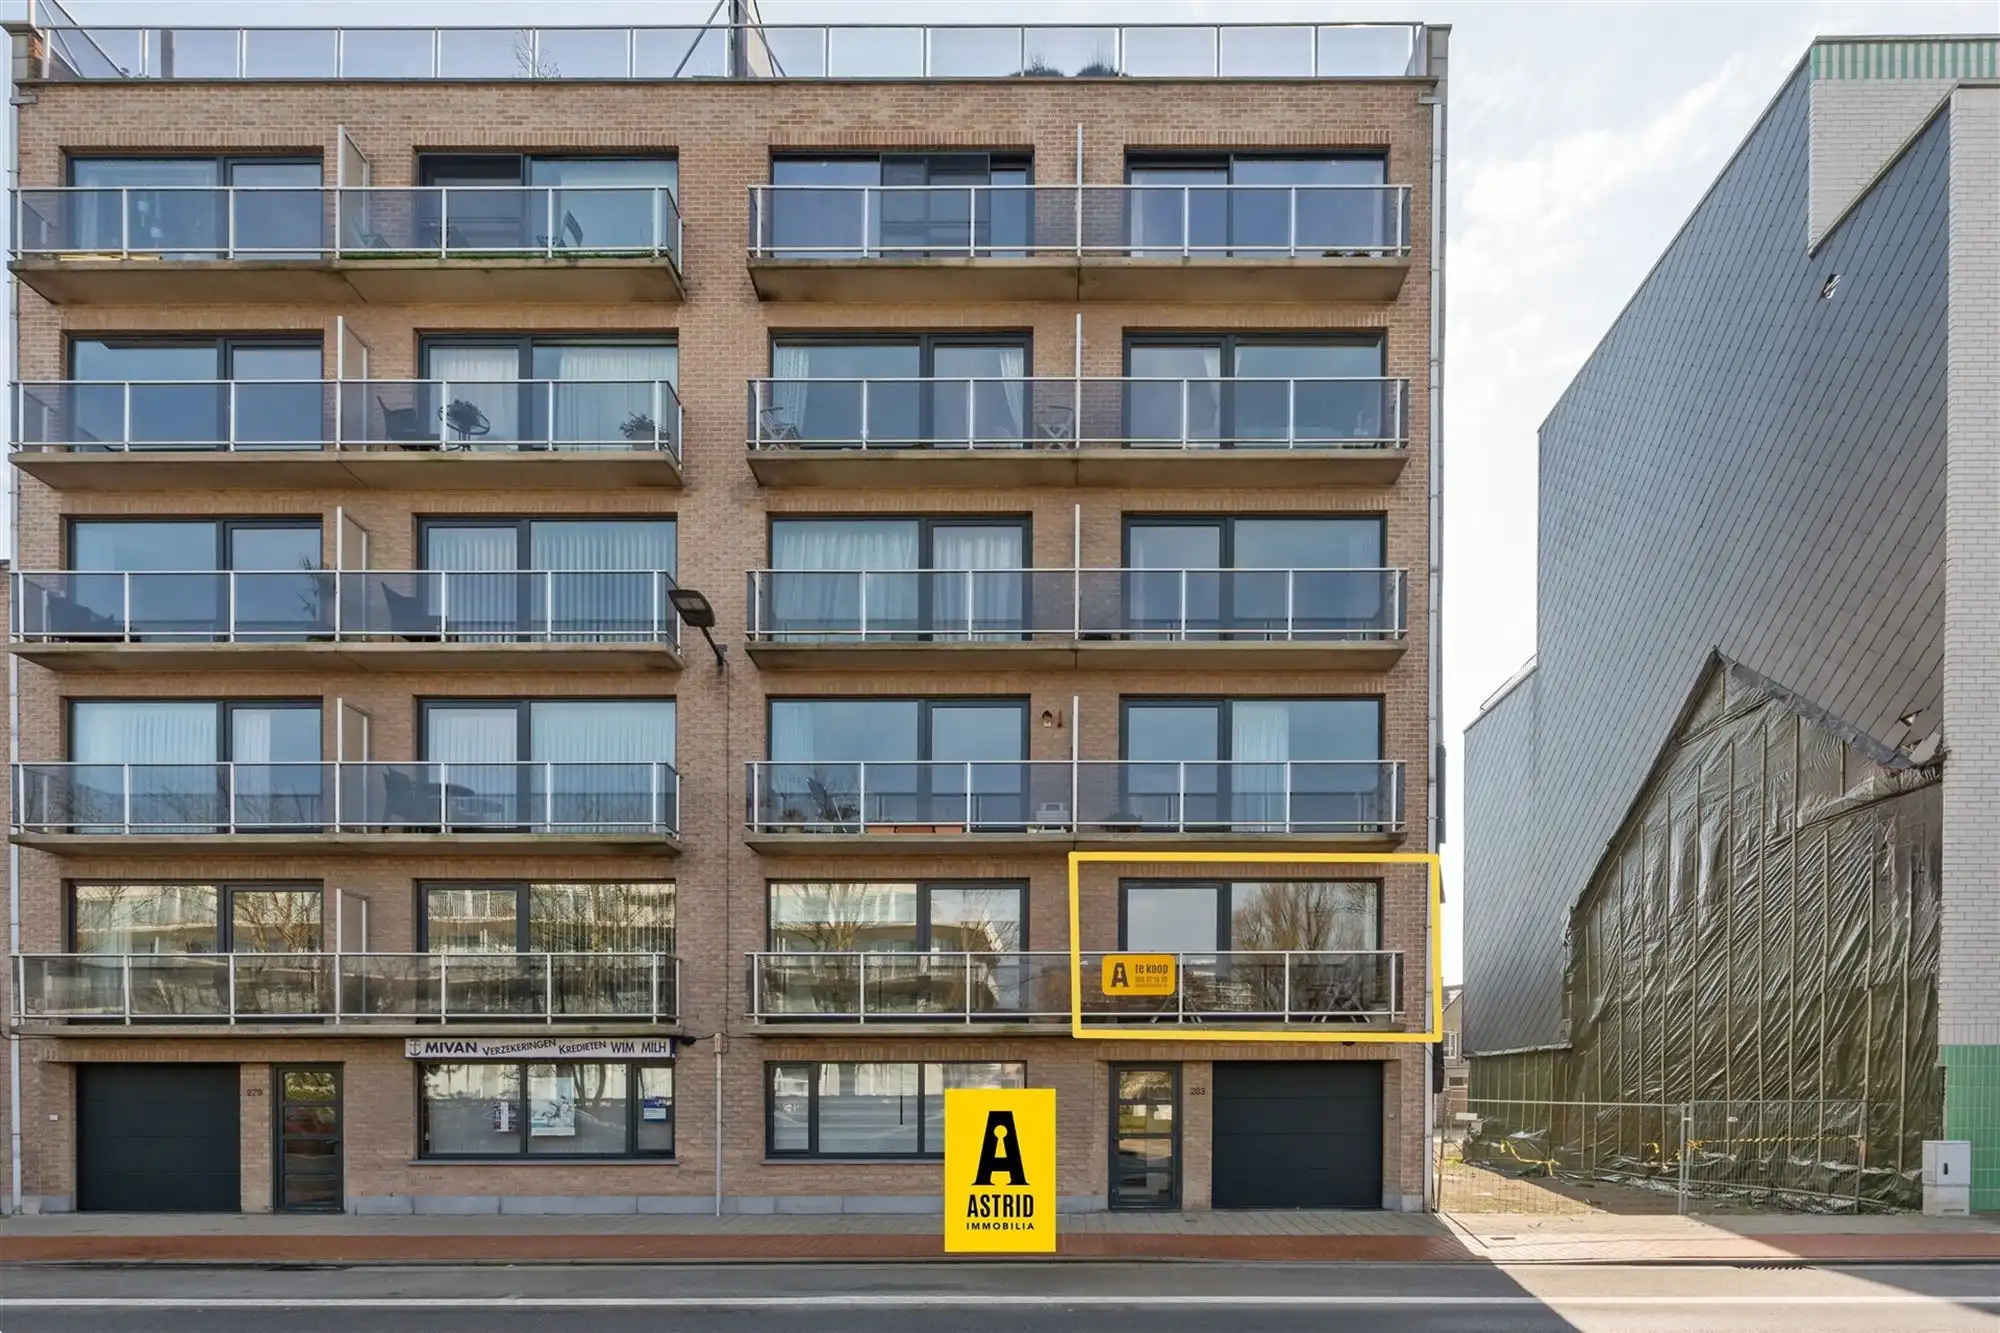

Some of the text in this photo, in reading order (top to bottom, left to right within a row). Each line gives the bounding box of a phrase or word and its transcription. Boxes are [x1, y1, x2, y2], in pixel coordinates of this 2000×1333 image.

[1135, 963, 1168, 975] te koop
[425, 1039, 667, 1056] MIVAN VERZEKERINGEN KREDIETEN WIM MILH
